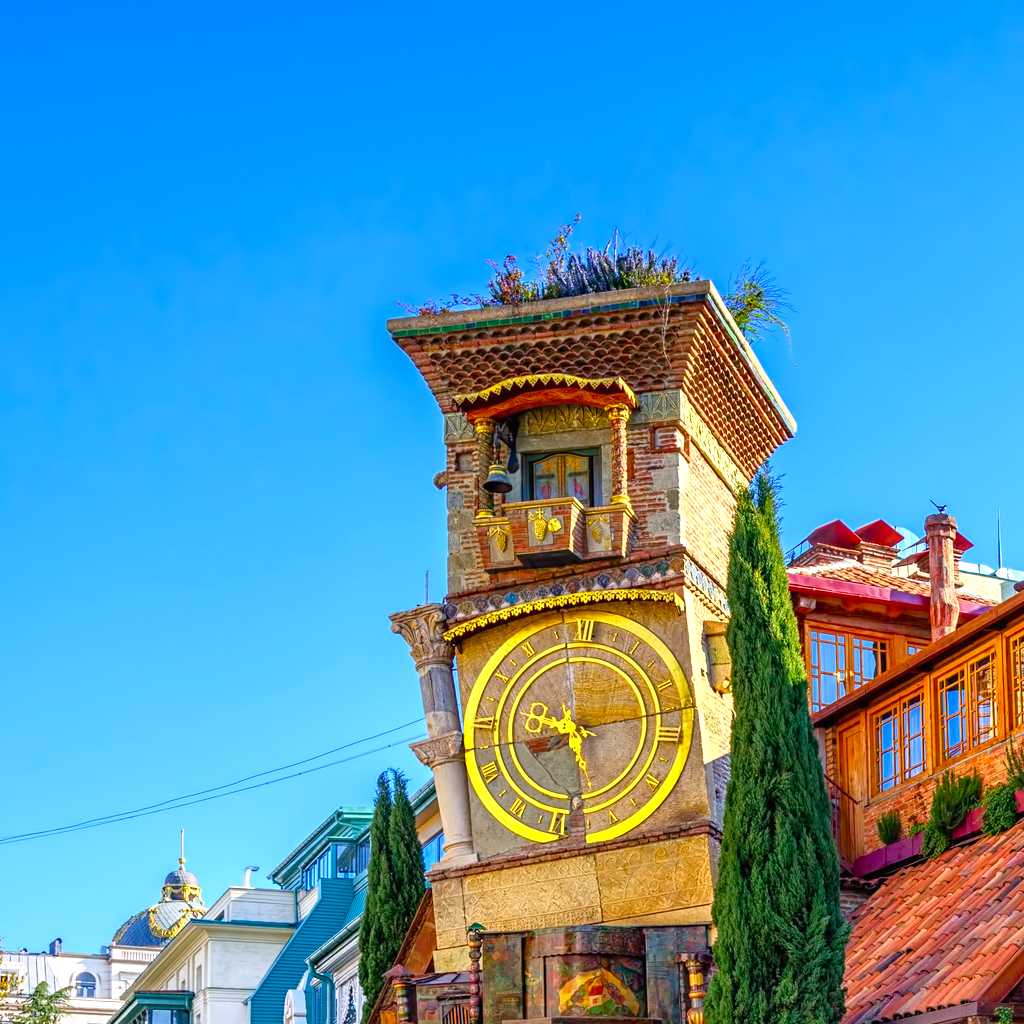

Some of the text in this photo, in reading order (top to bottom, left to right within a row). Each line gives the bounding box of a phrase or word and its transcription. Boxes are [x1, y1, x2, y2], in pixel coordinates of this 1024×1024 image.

[573, 618, 594, 641] XII
[521, 641, 535, 658] XI
[495, 671, 511, 684] X
[656, 679, 673, 692] II
[657, 726, 681, 741] III
[548, 812, 568, 836] VI
